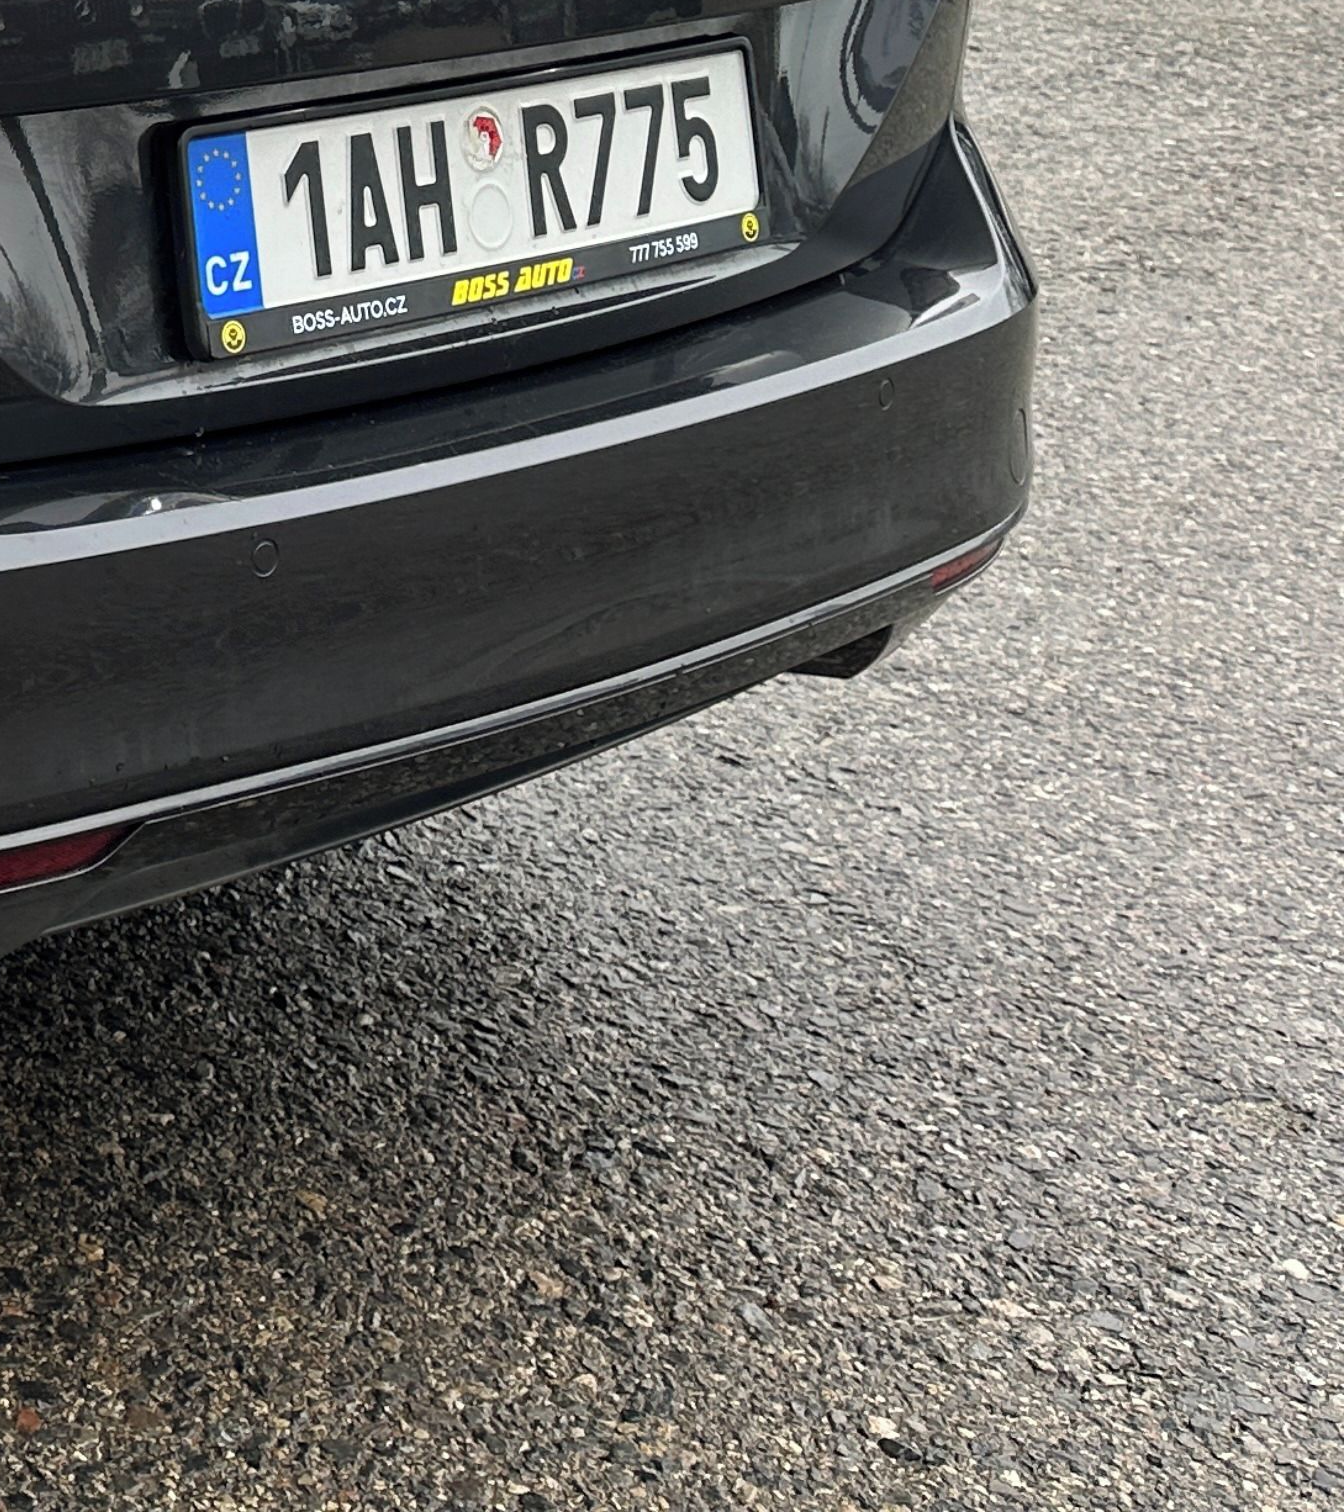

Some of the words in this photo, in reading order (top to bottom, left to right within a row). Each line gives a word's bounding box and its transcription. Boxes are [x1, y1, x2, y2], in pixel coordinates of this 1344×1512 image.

[204, 251, 253, 296] CZ
[283, 120, 458, 278] 1AH
[520, 76, 720, 238] R775
[628, 243, 650, 264] 777
[651, 237, 675, 259] 755
[676, 231, 699, 253] 599
[451, 271, 510, 306] BOSS
[514, 257, 574, 293] AUTO
[291, 295, 409, 335] BOSS-AUTO.CZ
